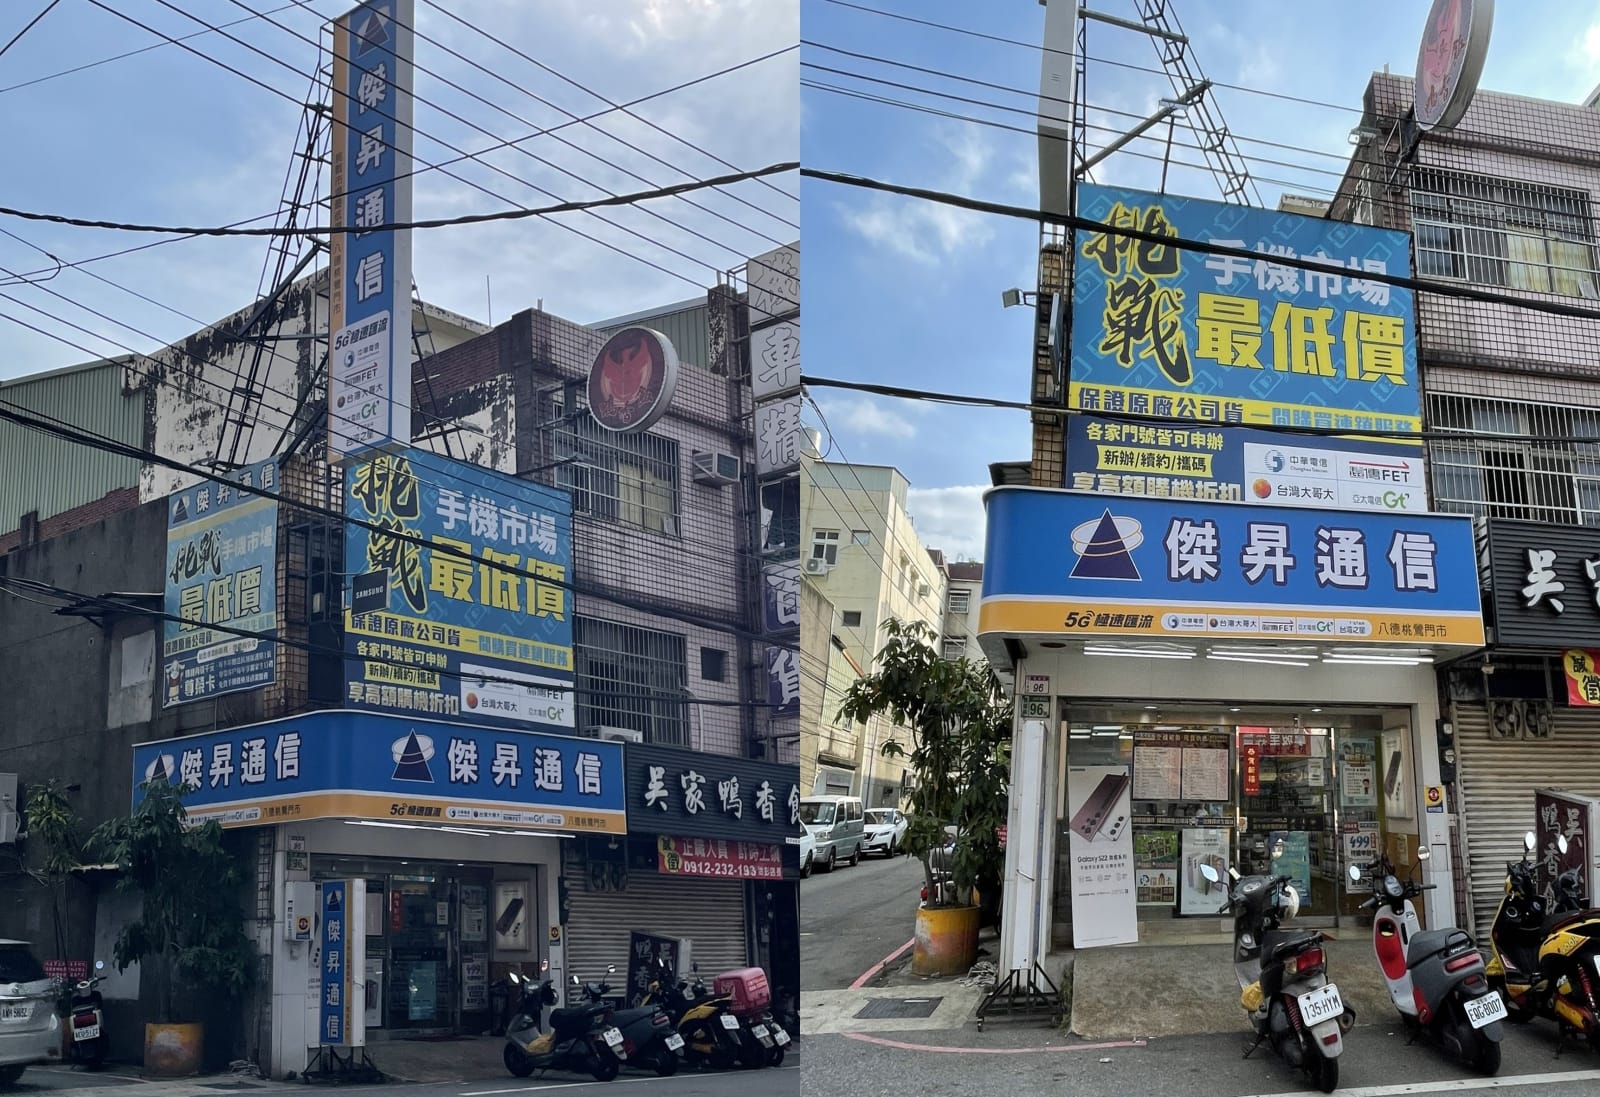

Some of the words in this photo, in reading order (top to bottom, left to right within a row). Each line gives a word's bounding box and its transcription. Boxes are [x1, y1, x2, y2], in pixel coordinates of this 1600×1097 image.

[355, 62, 387, 304] 傑昇通信
[1205, 238, 1391, 306] 手機市場
[1195, 293, 1409, 387] 最低價
[1079, 387, 1244, 424] 保證原廠公司貨
[1086, 422, 1224, 451] 各家門號皆可申辦
[1104, 450, 1206, 473] 新辦/續約/攜碼
[1289, 455, 1328, 468] 中華電信
[1277, 484, 1334, 501] 台灣大哥大
[436, 488, 558, 554] 手機市場
[1166, 518, 1438, 593] 傑昇通信
[355, 585, 385, 599] SAMSUNG
[428, 534, 566, 622] 最低價
[179, 565, 263, 632] 最低價
[1219, 619, 1257, 629] 台灣大哥大
[356, 640, 448, 669] 各家門號皆可申辦
[348, 681, 460, 716] 享高額購機折扣
[1033, 683, 1044, 692] 96
[481, 698, 518, 712] 台灣大哥大
[1030, 703, 1043, 715] 96
[180, 732, 301, 791] 傑昇通信
[447, 738, 602, 795] 傑昇通信
[1349, 835, 1370, 848] 499
[684, 860, 757, 877] 0912-232-193
[326, 919, 341, 1039] 傑昇通信
[1304, 994, 1341, 1020] 135-HYM
